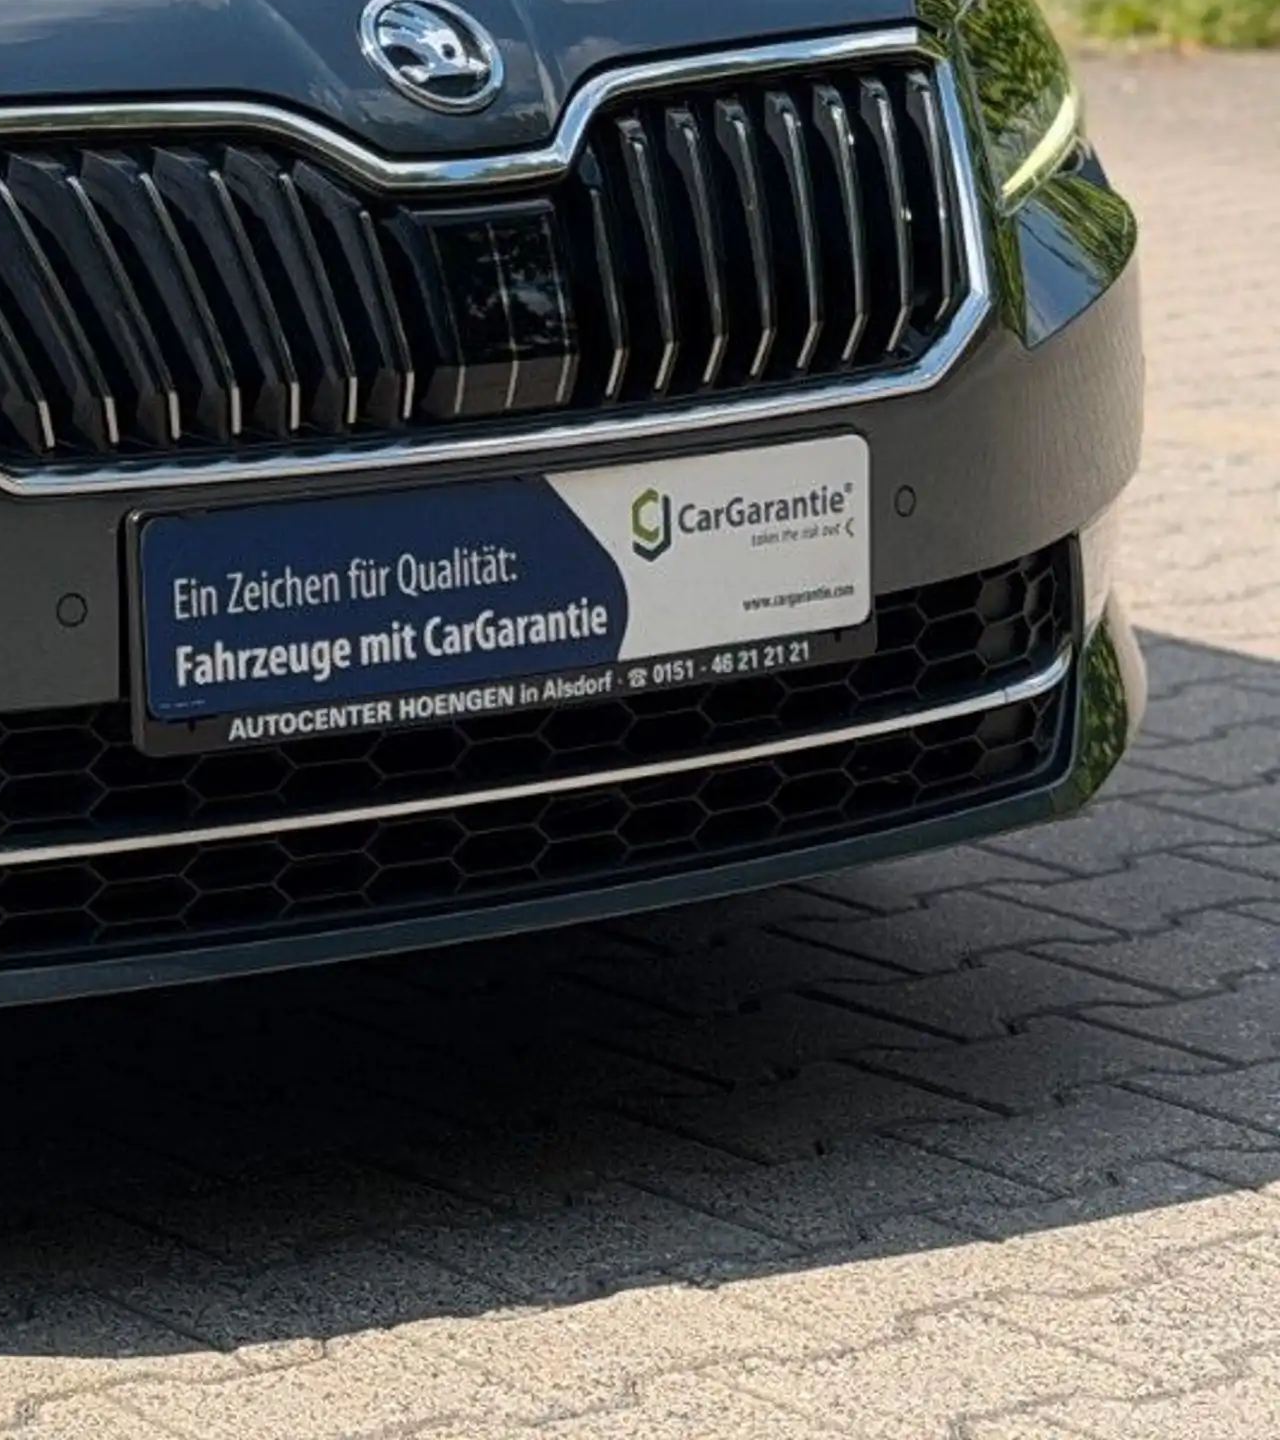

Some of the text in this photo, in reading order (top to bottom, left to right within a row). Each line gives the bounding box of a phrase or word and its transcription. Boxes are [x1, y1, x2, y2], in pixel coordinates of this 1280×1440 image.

[173, 546, 518, 620] Ein Zeichen für Qualität:
[175, 597, 608, 687] Fahrzeuge mit CarGarantie
[228, 700, 391, 742] AUTOCENTER
[399, 686, 514, 721] HOENGEN
[520, 684, 537, 705] in
[543, 669, 613, 701] Alsdorf
[653, 660, 694, 683] 0151
[738, 649, 758, 671] 21
[764, 644, 785, 666] 21
[789, 640, 810, 662] 21
